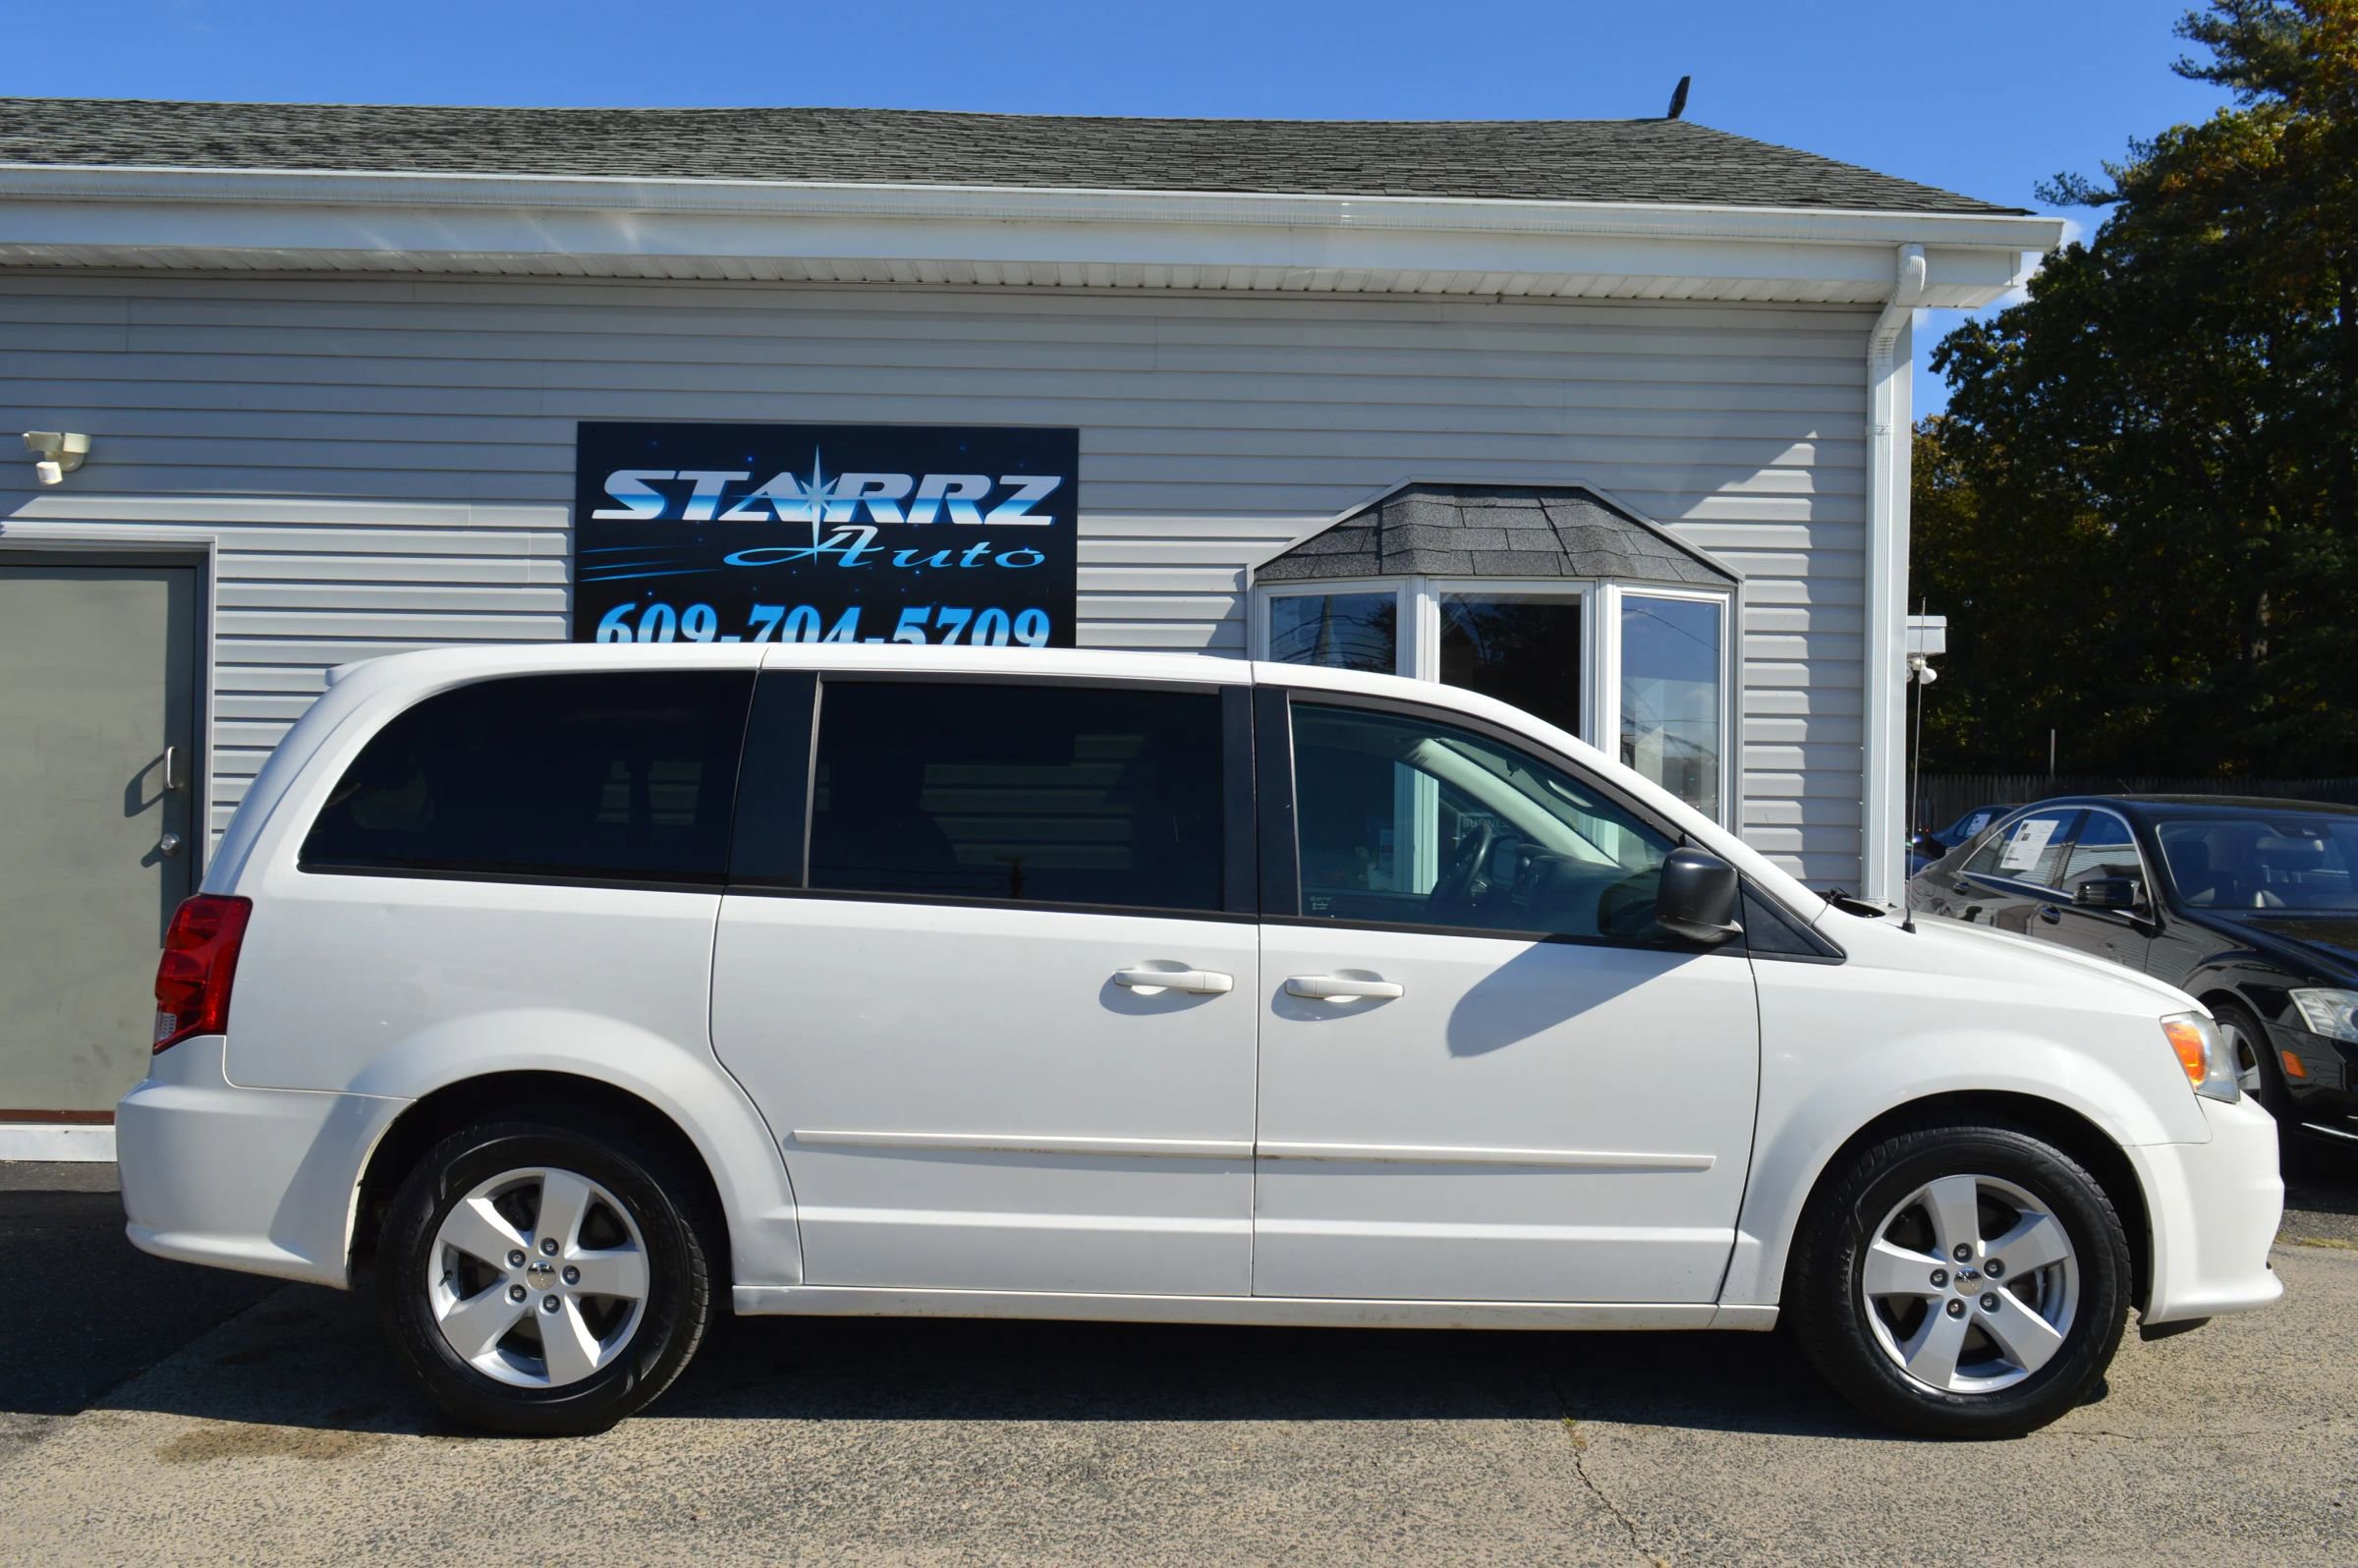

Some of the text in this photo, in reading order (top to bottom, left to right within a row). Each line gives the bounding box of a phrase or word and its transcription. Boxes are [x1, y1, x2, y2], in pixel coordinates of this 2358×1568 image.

[591, 469, 1062, 526] STARRZ
[723, 525, 1045, 568] Auto
[595, 602, 1050, 648] 609-704-5709
